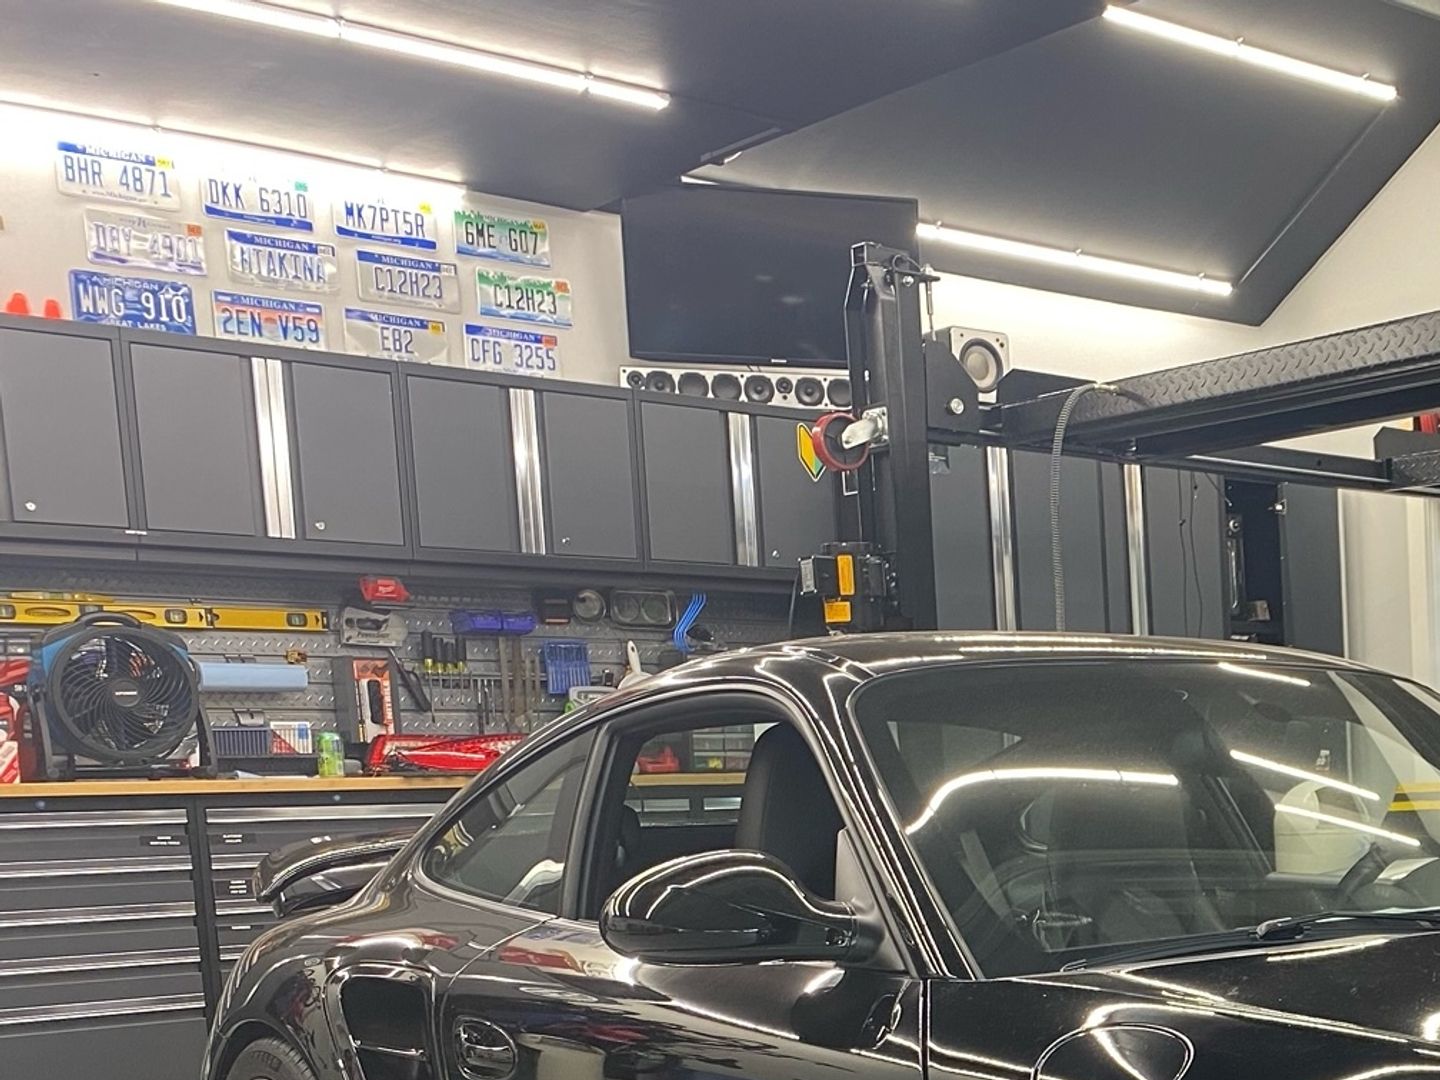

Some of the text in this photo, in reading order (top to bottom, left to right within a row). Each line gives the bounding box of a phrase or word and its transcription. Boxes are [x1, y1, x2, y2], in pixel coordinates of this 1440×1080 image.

[64, 155, 172, 198] BHR 4871
[208, 179, 307, 219] DKK 6310
[345, 200, 426, 238] MK7PT5R
[253, 235, 309, 252] MICHIGAN
[465, 221, 497, 249] 6ME
[381, 255, 433, 270] MICHIGAN
[102, 275, 158, 291] MICHIGAN
[374, 266, 443, 300] C12H23
[79, 283, 187, 323] WWG 910
[240, 295, 296, 311] MICHIGAN
[494, 284, 557, 315] C12H23
[221, 307, 320, 344] 2EN V59
[371, 312, 421, 327] MICHIGAN
[514, 344, 556, 371] 3255
